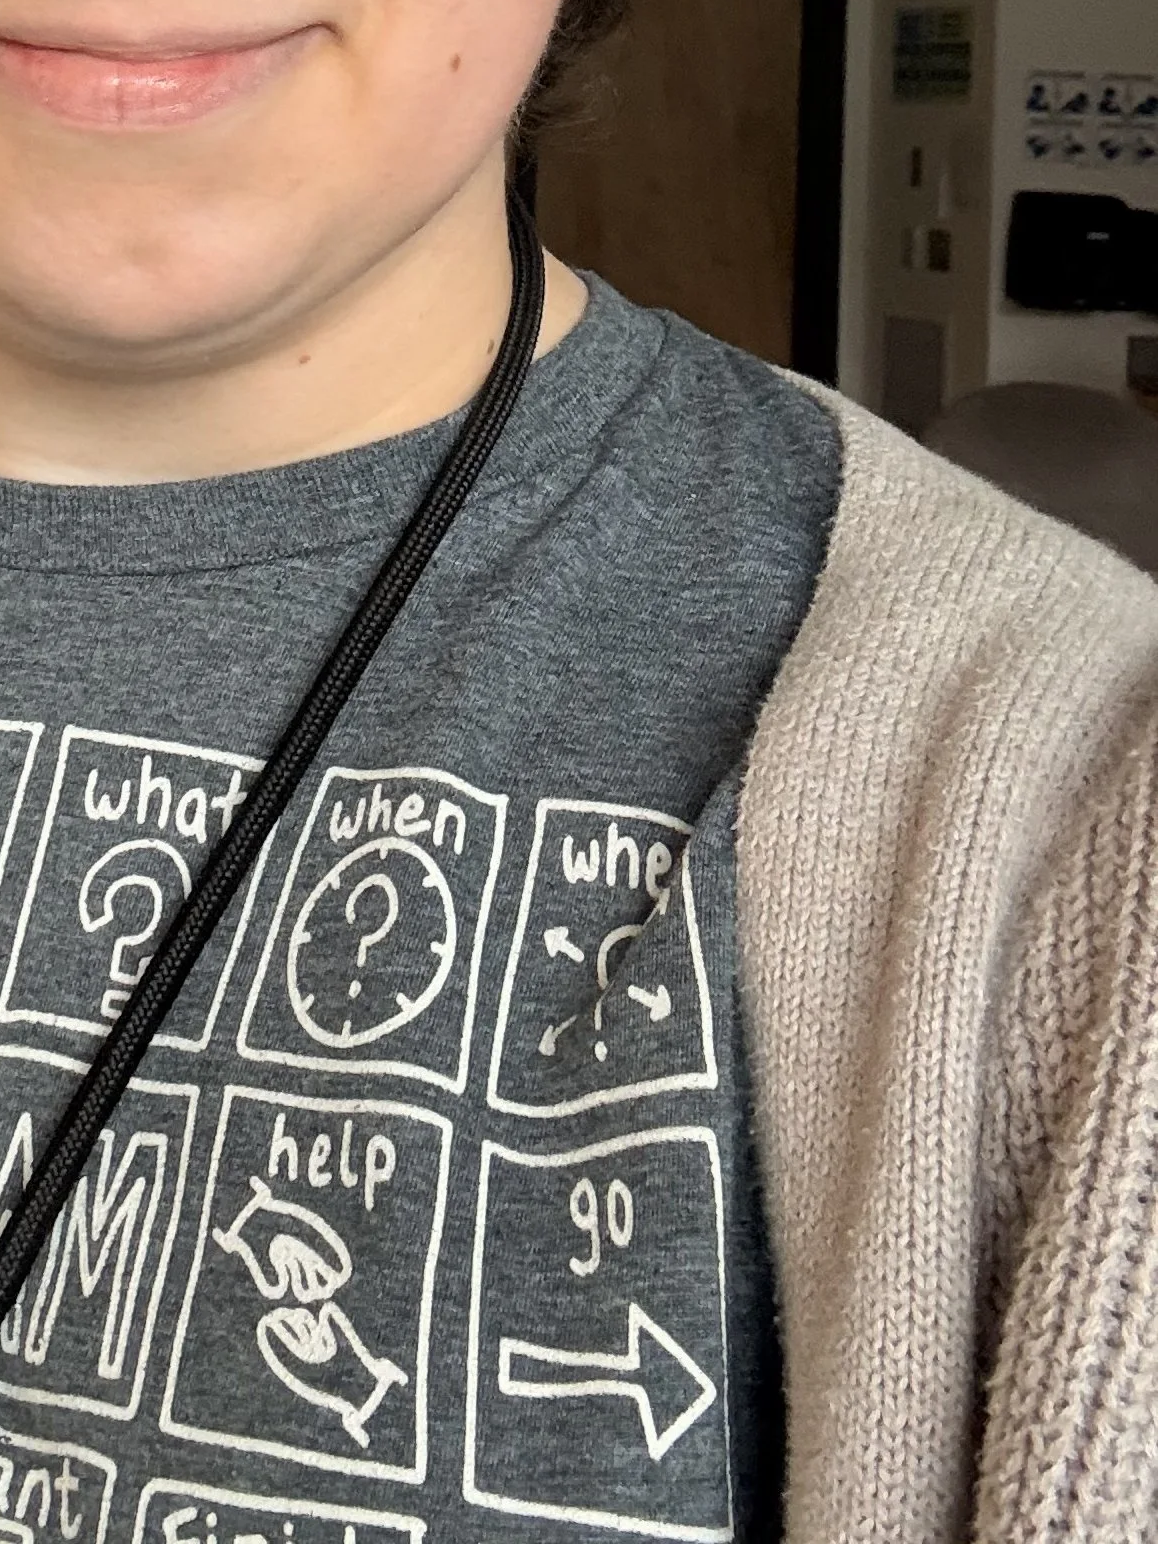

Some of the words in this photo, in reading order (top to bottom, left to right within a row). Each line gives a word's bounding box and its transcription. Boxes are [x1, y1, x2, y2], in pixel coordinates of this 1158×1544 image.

[84, 754, 248, 844] what
[329, 782, 465, 854] when
[267, 1112, 396, 1212] help
[569, 1177, 634, 1278] go
